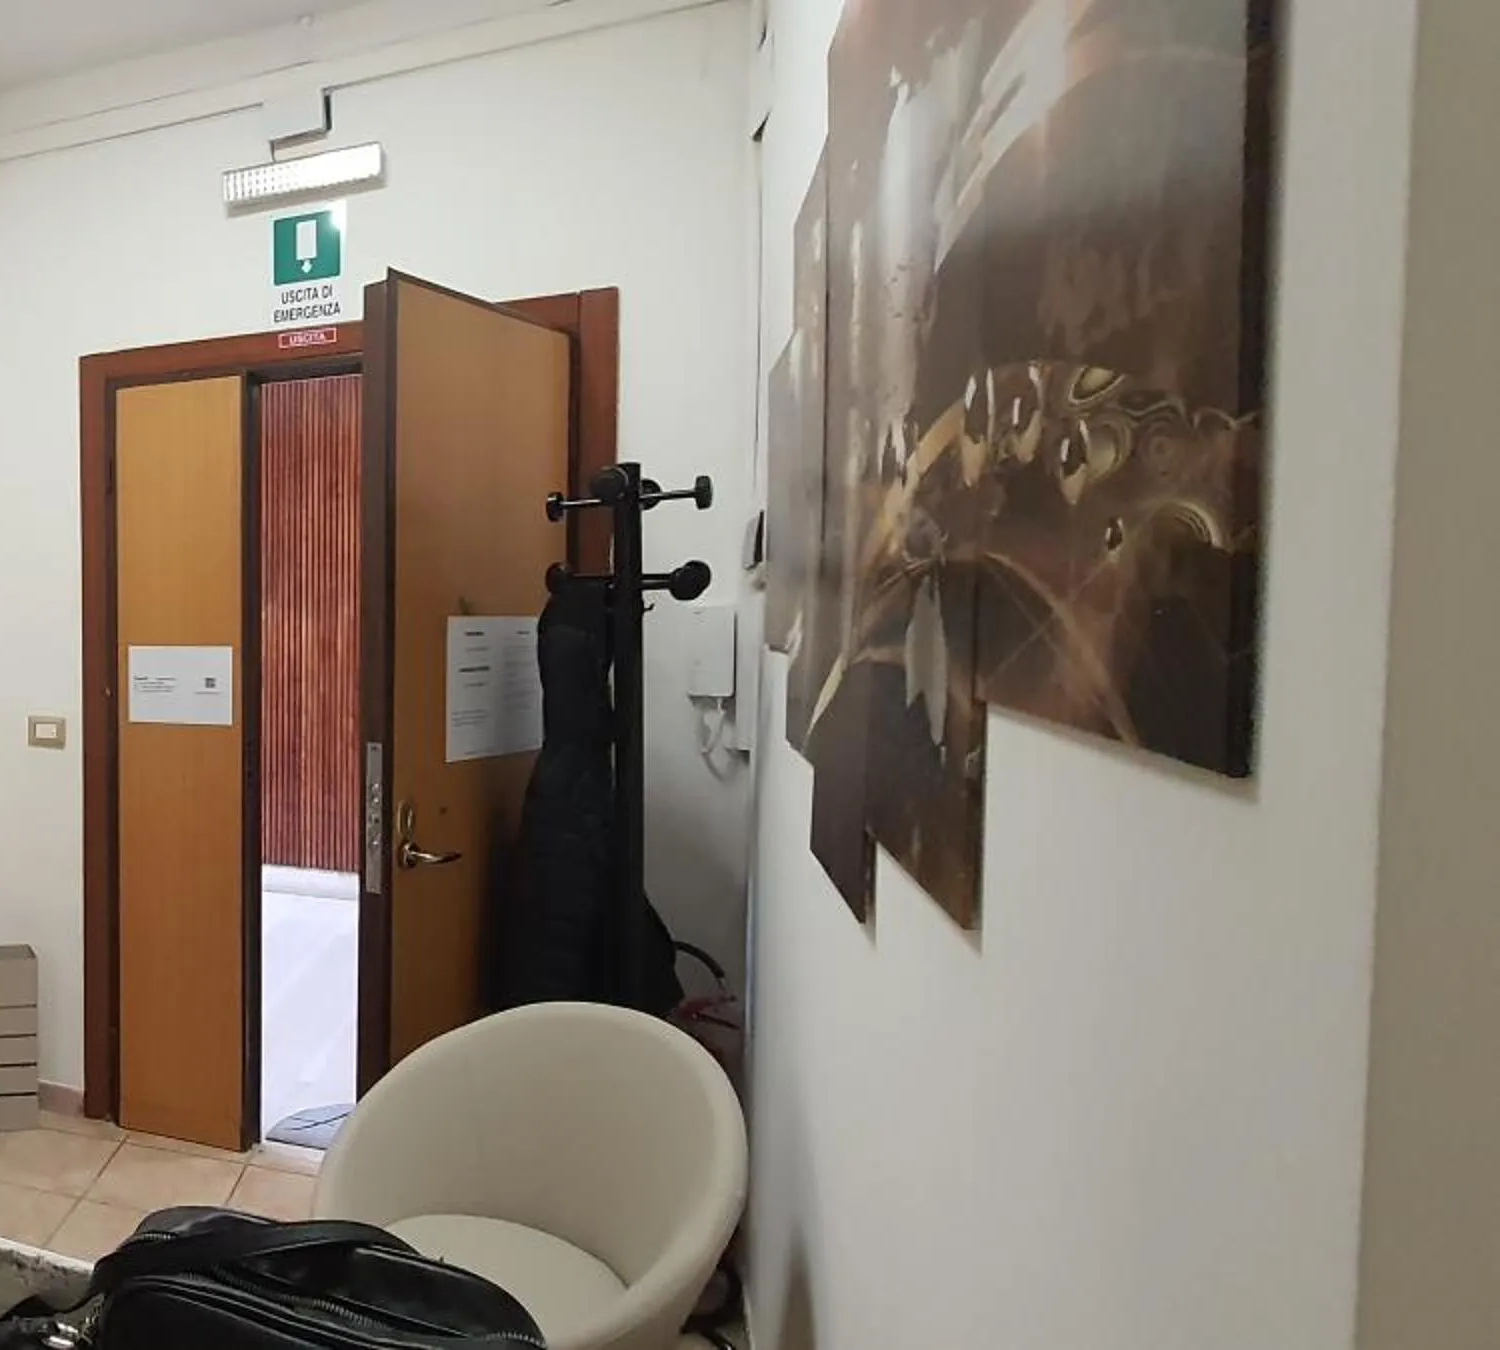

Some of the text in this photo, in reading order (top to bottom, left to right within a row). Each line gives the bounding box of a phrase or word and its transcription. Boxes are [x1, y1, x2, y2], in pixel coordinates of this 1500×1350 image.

[280, 285, 333, 304] USCITA DI
[273, 301, 341, 323] EMERGENZA
[288, 331, 326, 346] USCITA
